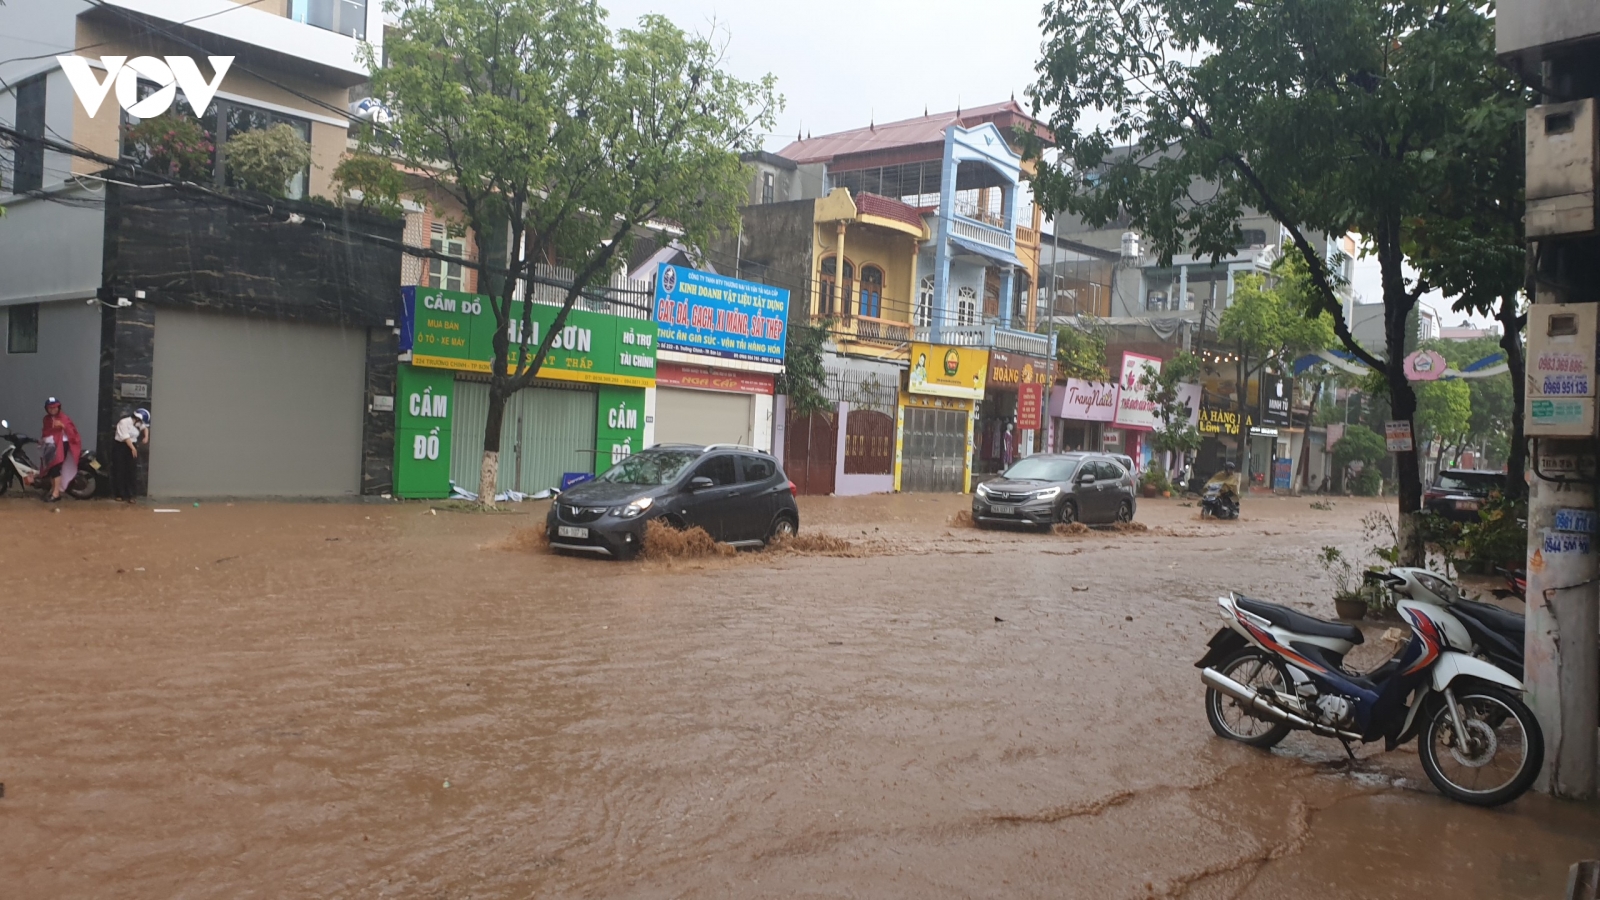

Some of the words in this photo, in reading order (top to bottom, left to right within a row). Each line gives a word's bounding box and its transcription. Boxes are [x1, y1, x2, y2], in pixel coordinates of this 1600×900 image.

[424, 292, 456, 312] CẦM
[461, 297, 481, 315] ĐỒ
[679, 281, 697, 296] KINH
[698, 285, 722, 300] DOANH
[723, 289, 737, 304] VẬT
[737, 292, 752, 307] LIỆU
[752, 295, 766, 308] XÂY
[767, 299, 784, 312] DỰNG
[427, 319, 442, 329] MUA
[444, 319, 459, 330] BÁN
[715, 308, 725, 332] XI
[751, 308, 765, 338] SẮT
[765, 314, 783, 340] THÉP
[418, 332, 423, 342] Ô
[426, 334, 435, 343] TÔ
[441, 336, 449, 345] XE
[451, 336, 465, 347] MÁY
[551, 325, 591, 353] SƠN
[636, 333, 653, 350] TRỢ
[676, 329, 687, 342] ĂN
[688, 333, 702, 343] GIA
[703, 334, 716, 346] SÚC
[721, 337, 735, 349] VẬN
[736, 338, 747, 350] TẢI
[747, 341, 766, 353] HÀNG
[767, 344, 781, 355] HÓA
[426, 358, 449, 367] TRƯỜNG
[566, 356, 593, 369] THẤP
[619, 351, 632, 366] TÀI
[632, 353, 654, 369] CHÍNH
[682, 377, 709, 386] NGA
[993, 364, 1018, 383] HOÀNG
[1561, 381, 1574, 394] 951
[1575, 381, 1588, 394] 136
[409, 385, 448, 419] CẦM
[608, 401, 637, 430] CẦM
[1210, 408, 1236, 425] HÀNG
[413, 426, 440, 461] ĐỒ
